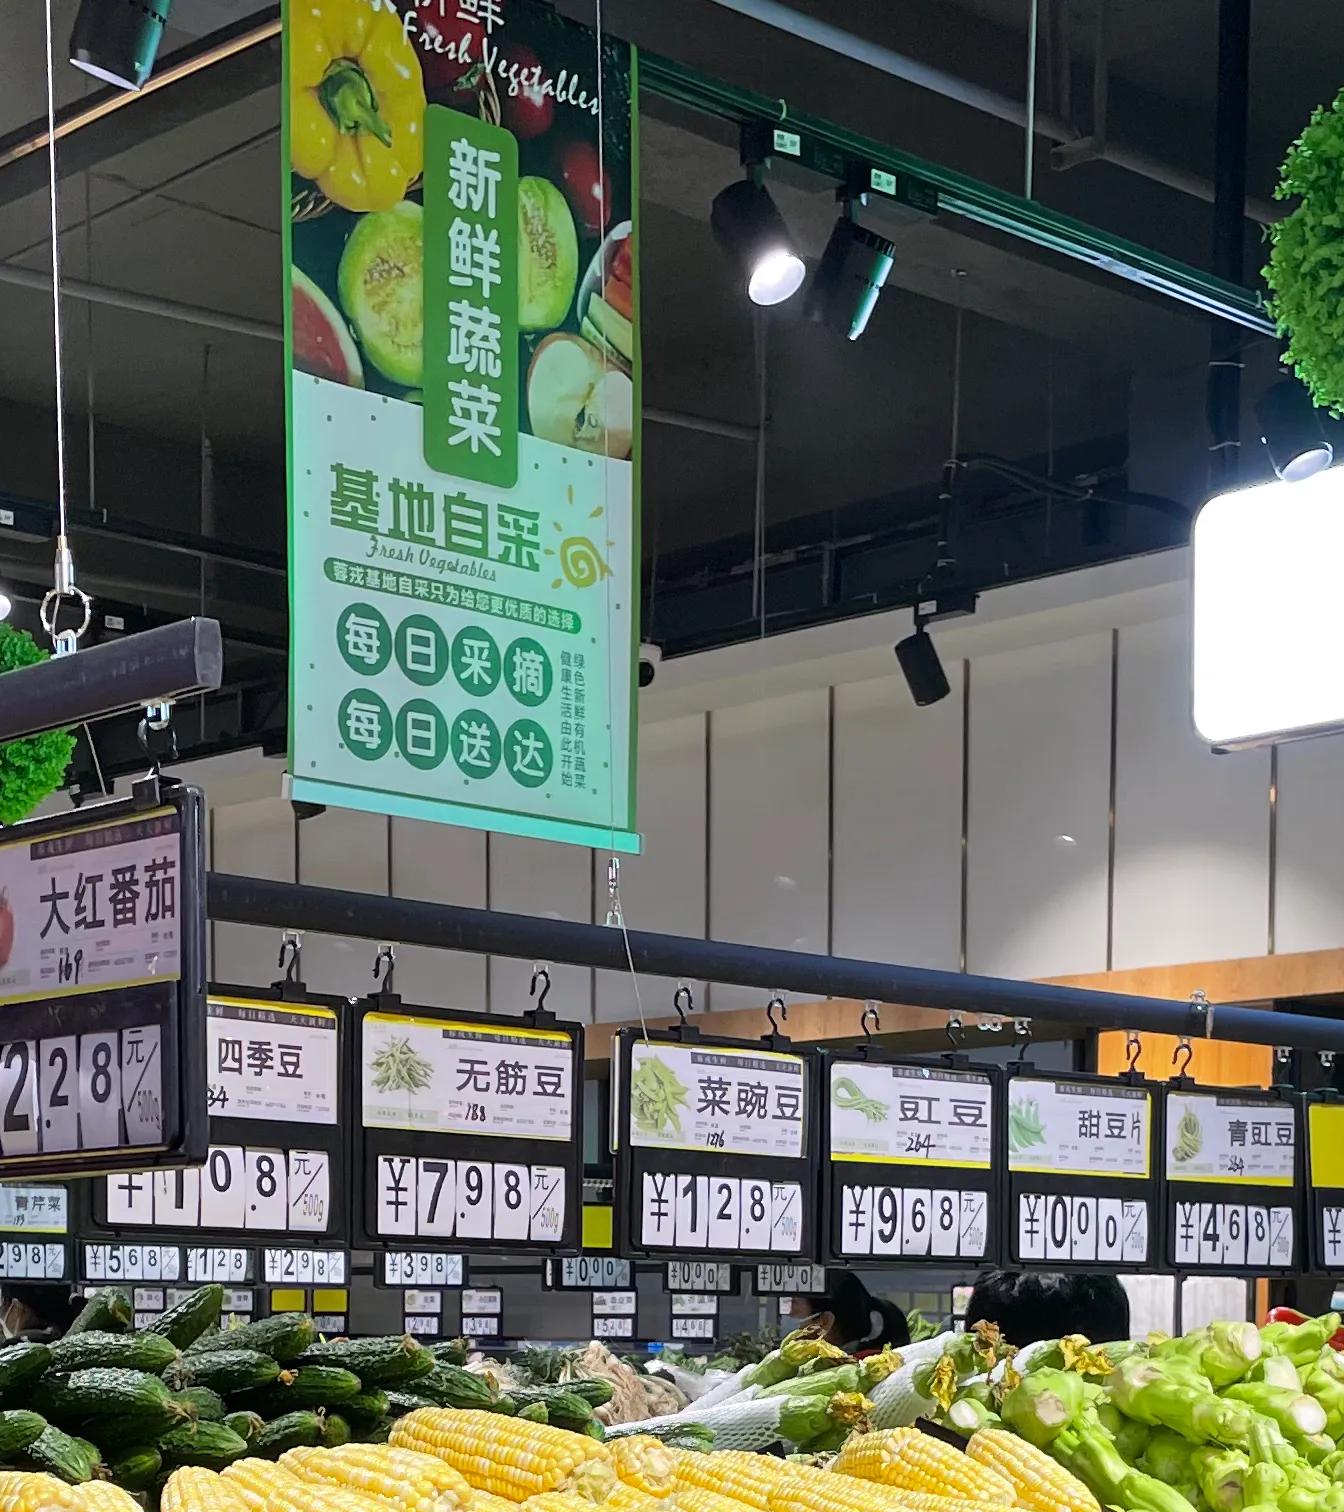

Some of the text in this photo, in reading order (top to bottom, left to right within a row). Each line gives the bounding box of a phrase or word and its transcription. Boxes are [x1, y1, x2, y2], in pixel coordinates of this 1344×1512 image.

[402, 10, 472, 64] Fresh
[483, 38, 600, 115] Vegetables
[447, 137, 502, 457] 新鲜蔬菜
[330, 462, 541, 573] 基地自采
[365, 535, 496, 582] Fresh Vegetables
[344, 612, 544, 697] 每日采摘
[346, 699, 544, 778] 每日送达
[40, 856, 176, 939] 大红番茄
[217, 1037, 303, 1080] 四季豆
[456, 1058, 566, 1098] 无筋豆
[697, 1076, 803, 1122] 菜豌豆
[898, 1094, 988, 1128] 豇豆
[1078, 1109, 1141, 1146] 甜豆片
[1228, 1119, 1295, 1147] 青豇豆
[383, 1157, 522, 1224] ¥7.98
[648, 1173, 765, 1235] ¥12.8
[846, 1184, 953, 1245] ¥9.68
[1022, 1195, 1117, 1249] ¥0.00
[1180, 1200, 1265, 1252] ¥4.68
